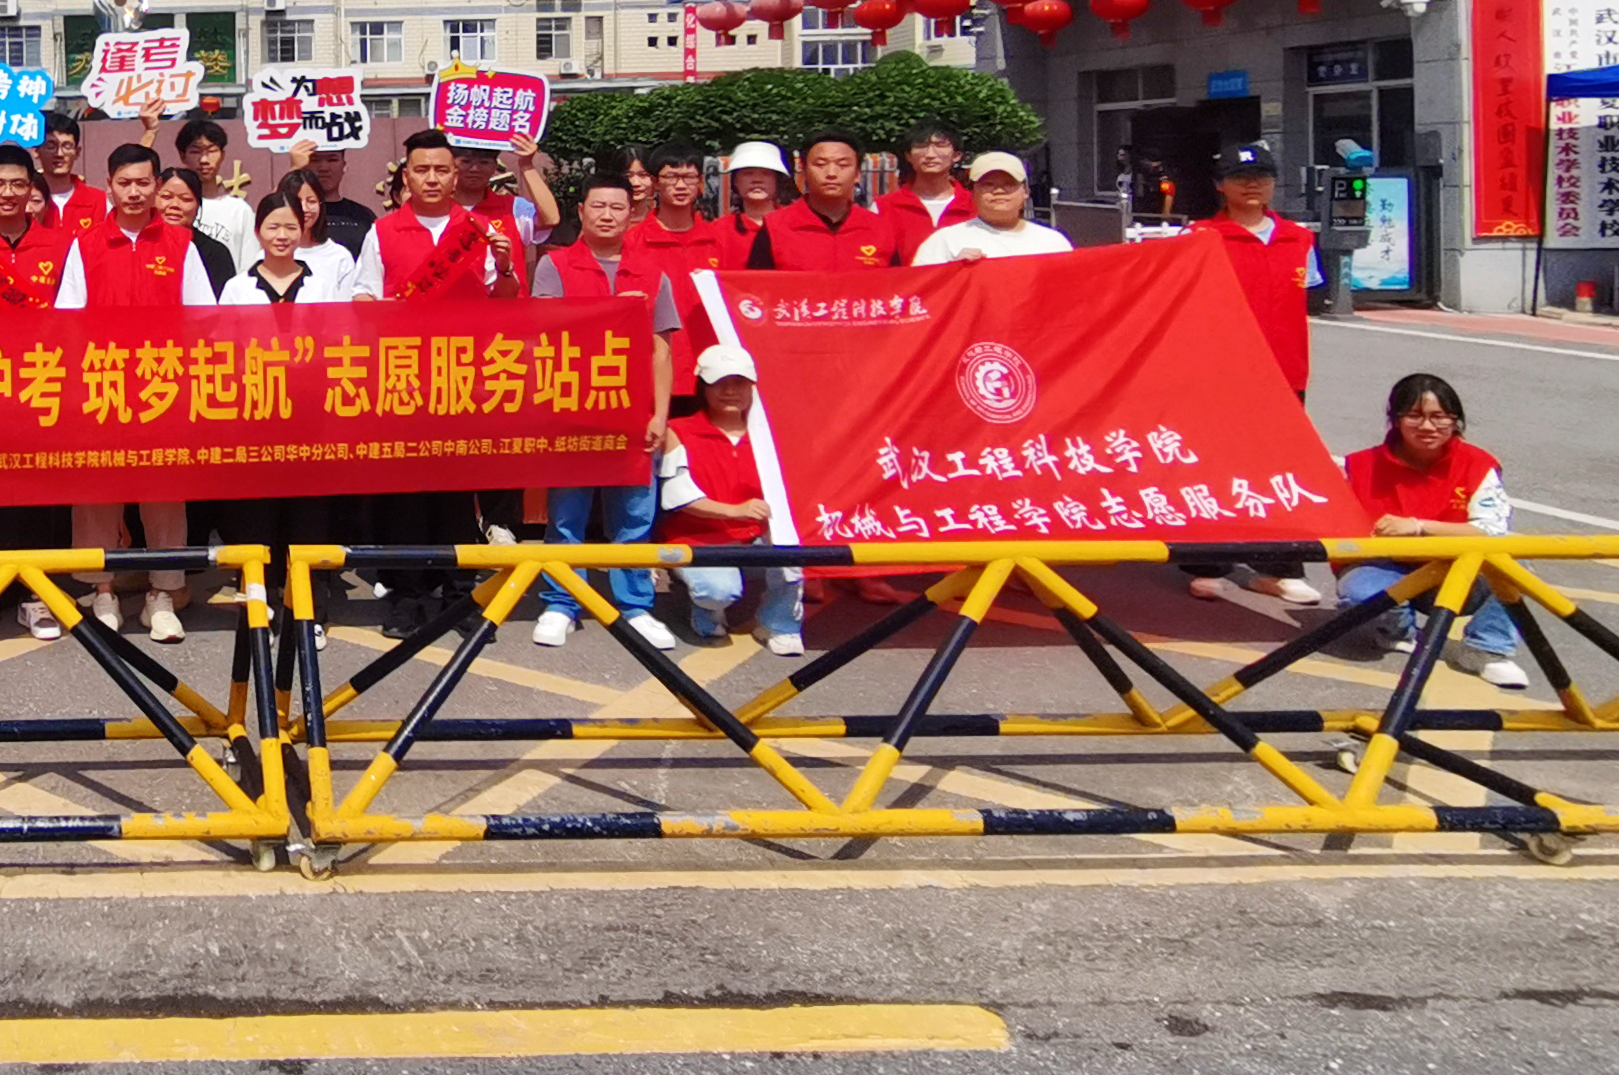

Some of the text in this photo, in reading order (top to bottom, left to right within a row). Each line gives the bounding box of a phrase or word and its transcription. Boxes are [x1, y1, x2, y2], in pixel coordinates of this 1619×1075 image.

[98, 36, 182, 75] 逢考
[112, 69, 197, 107] 必过
[446, 81, 537, 112] 扬帆起航
[443, 104, 533, 134] 金榜题名
[875, 424, 1200, 490] 武汉工程科技学院
[814, 472, 1330, 542] 机械与工程学院志愿服务队
